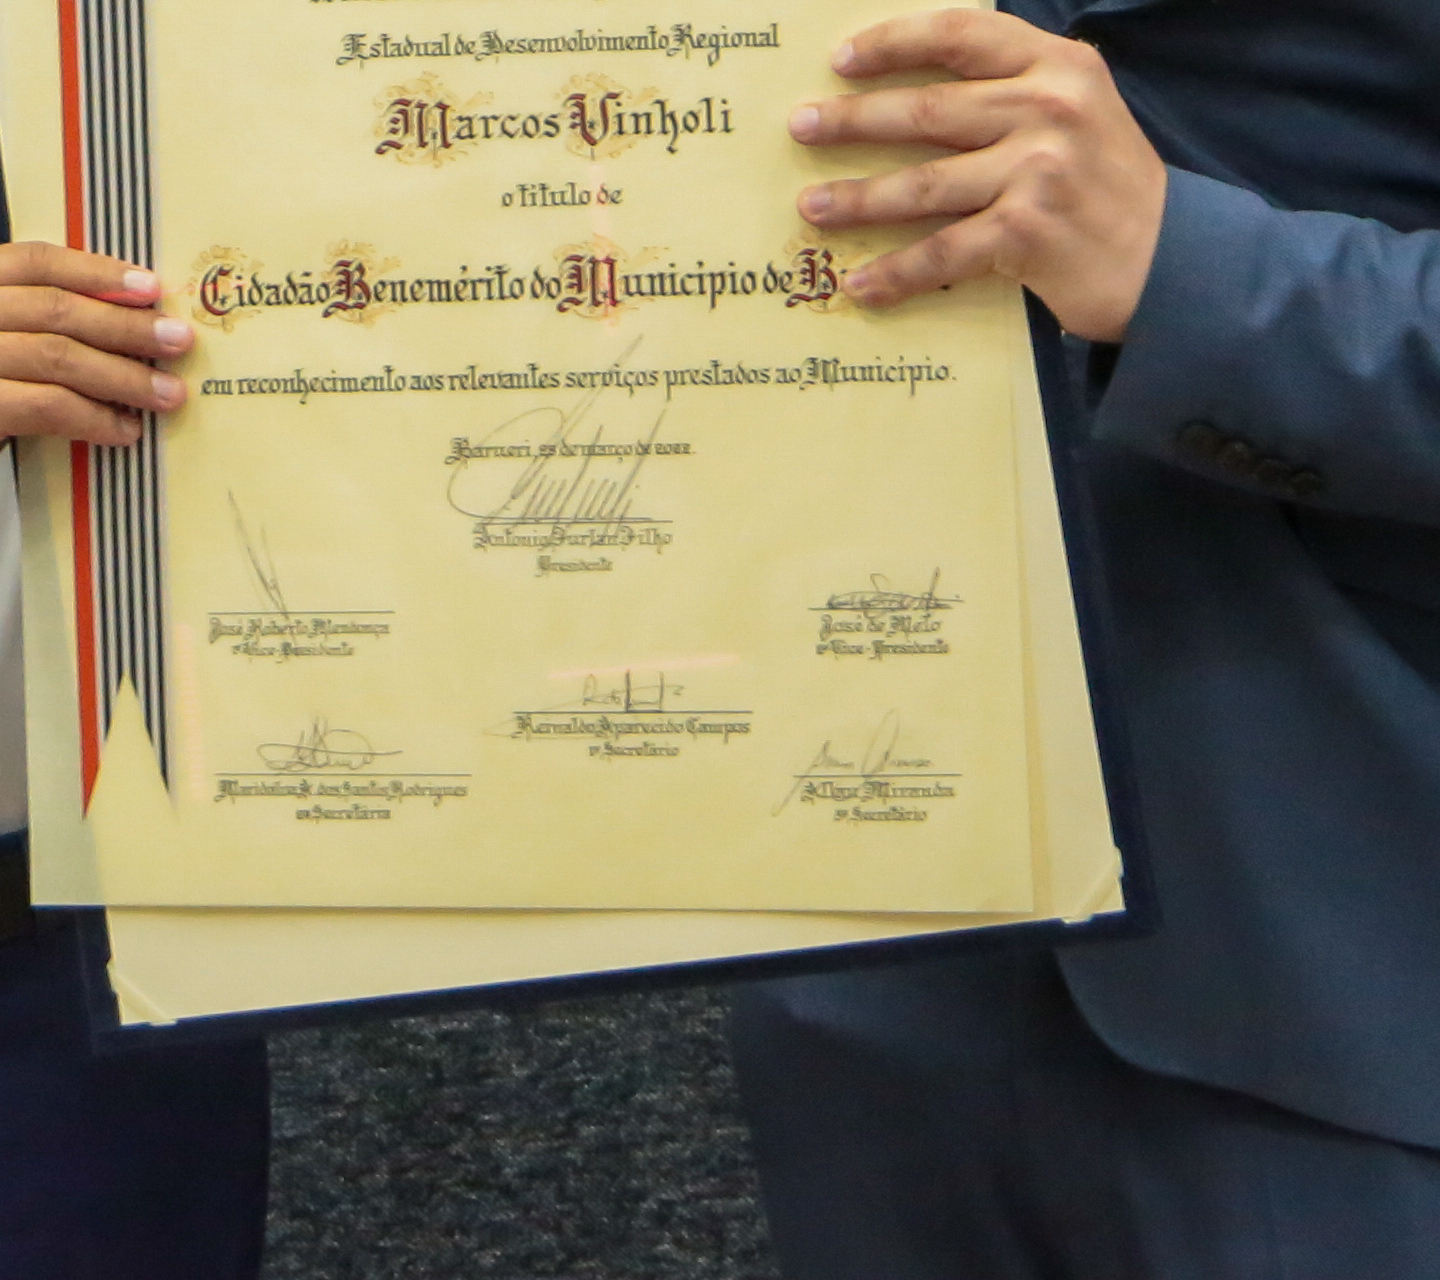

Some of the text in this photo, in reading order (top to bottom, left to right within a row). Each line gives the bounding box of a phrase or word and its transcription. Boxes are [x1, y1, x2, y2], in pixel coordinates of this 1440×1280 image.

[336, 23, 781, 67] Estadual de Desenvolvimento Regional
[375, 91, 735, 156] Marcos Vinholi
[500, 190, 513, 208] o
[596, 182, 624, 205] de
[200, 264, 331, 317] Cidadão
[322, 259, 526, 318] Benemérito
[529, 265, 562, 300] do
[763, 262, 795, 293] de
[201, 376, 233, 396] em
[237, 365, 407, 404] reconhecimento
[410, 373, 446, 392] aos
[448, 363, 561, 392] relevantes
[564, 364, 659, 397] serviços
[662, 360, 771, 402] prestados
[775, 368, 803, 385] ao
